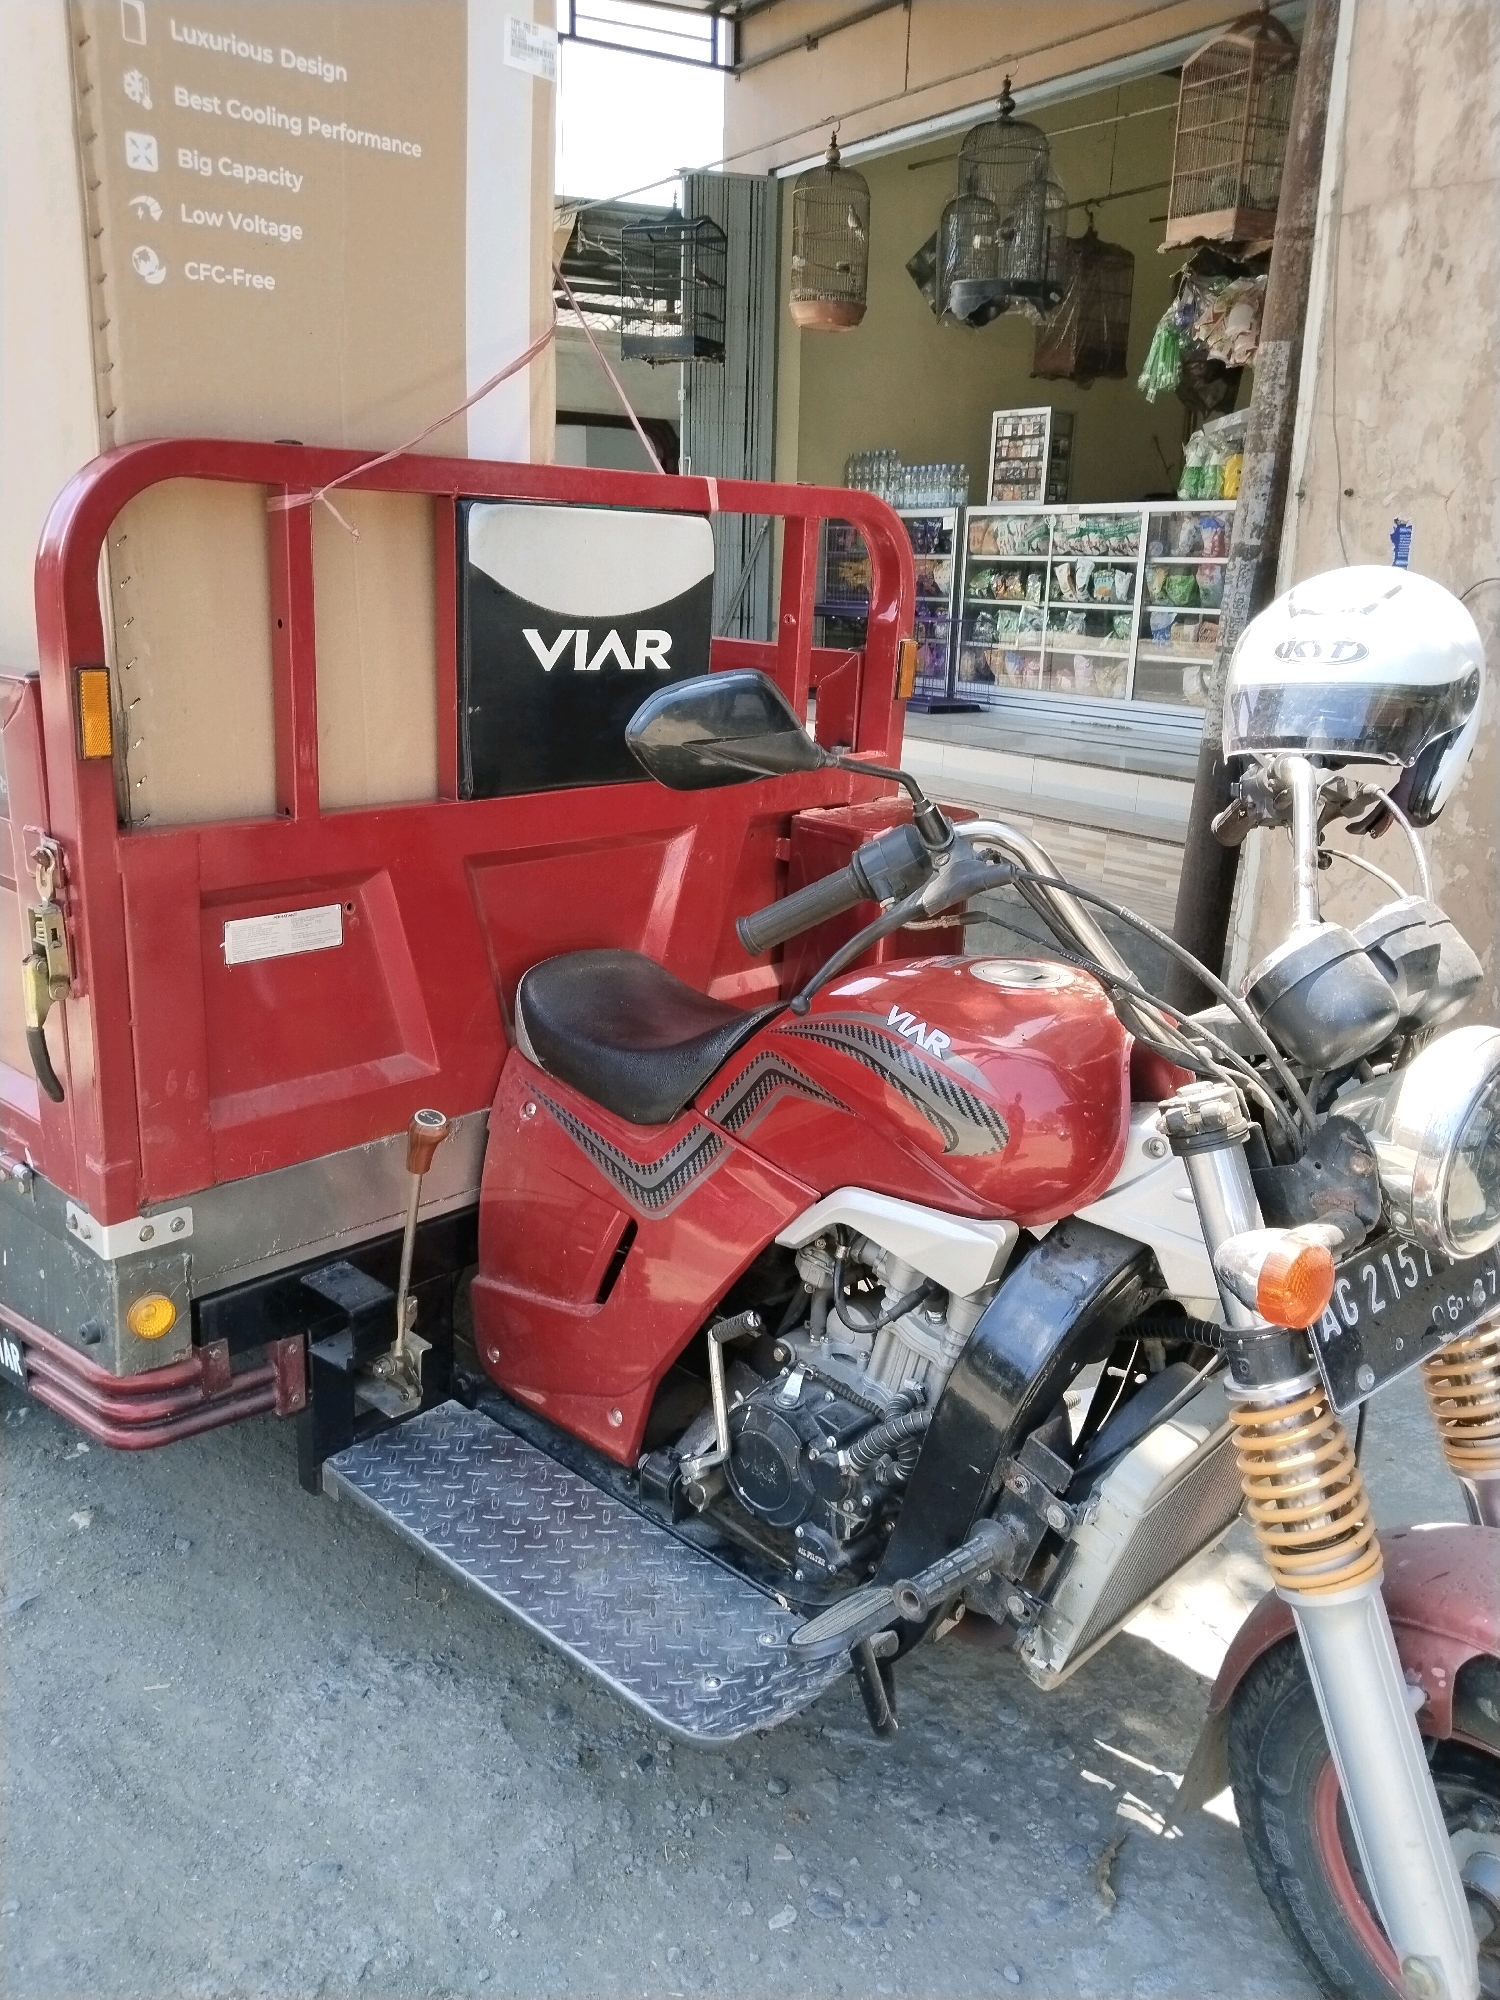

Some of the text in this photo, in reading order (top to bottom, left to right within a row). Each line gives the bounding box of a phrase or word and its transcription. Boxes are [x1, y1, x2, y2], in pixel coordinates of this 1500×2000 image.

[170, 18, 348, 83] Luxurious Design
[174, 86, 422, 158] Best Cooling Performance
[177, 148, 304, 193] Big Capacity
[181, 203, 303, 242] Low Voltage
[184, 261, 276, 290] CFC-Free
[522, 629, 673, 671] VIAR
[886, 1004, 951, 1059] VIAR
[1322, 1278, 1359, 1342] AG
